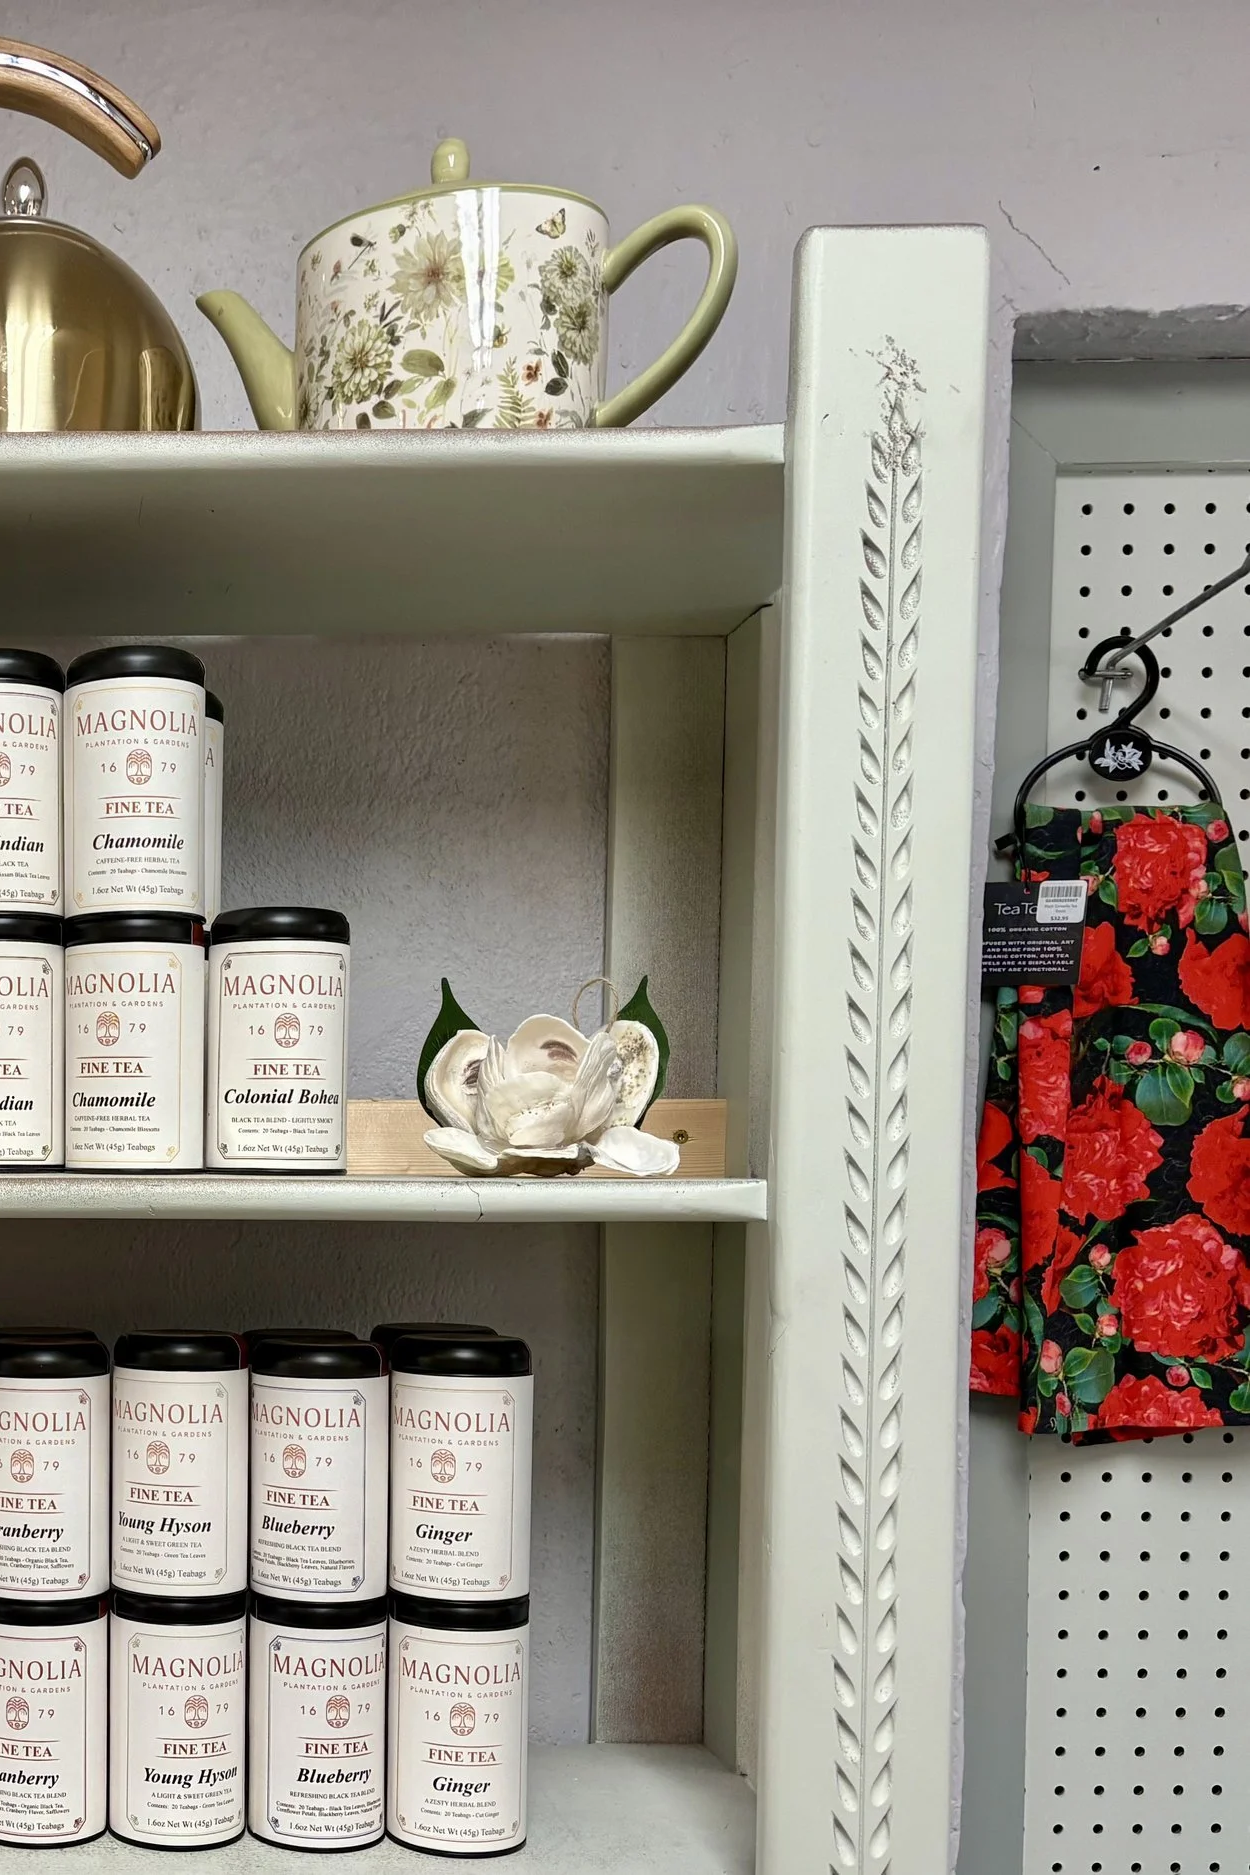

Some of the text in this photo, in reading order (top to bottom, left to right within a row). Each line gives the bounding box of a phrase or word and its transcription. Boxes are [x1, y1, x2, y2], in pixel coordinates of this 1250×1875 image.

[77, 709, 197, 736] MAGNOLIA
[4, 803, 33, 816] TEA
[105, 801, 174, 815] FINE TEA
[92, 834, 184, 850] Chamomile
[994, 903, 1020, 915] Tea
[67, 973, 176, 995] MAGNOLIA
[224, 974, 343, 997] MAGNOLIA
[80, 1062, 144, 1074] FINE TEA
[253, 1064, 321, 1076] FINE TEA
[73, 1092, 156, 1108] Chamomile
[225, 1089, 339, 1105] Colonial Bohea
[257, 1144, 271, 1152] Net
[272, 1144, 283, 1152] Wt
[285, 1144, 304, 1154] (45g)
[306, 1145, 328, 1153] Teabags
[114, 1400, 223, 1424] MAGNOLIA
[251, 1403, 361, 1428] MAGNOLIA
[394, 1406, 510, 1432] MAGNOLIA
[130, 1487, 193, 1503] FINE TEA
[266, 1490, 330, 1506] FINE TEA
[27, 1499, 57, 1510] TEA
[412, 1495, 479, 1512] FINE TEA
[118, 1512, 212, 1538] Young Hyson
[262, 1515, 335, 1539] Blueberry
[416, 1524, 473, 1545] Ginger
[132, 1650, 243, 1678] MAGNOLIA
[274, 1651, 385, 1678] MAGNOLIA
[402, 1657, 521, 1685] MAGNOLIA
[410, 1686, 462, 1698] PLANTATION
[23, 1746, 52, 1757] TEA
[163, 1740, 227, 1755] FINE TEA
[305, 1741, 368, 1755] FINE TEA
[429, 1748, 496, 1763] FINE TEA
[143, 1765, 238, 1789] Young Hyson
[297, 1767, 371, 1784] Blueberry
[432, 1776, 490, 1796] Ginger
[432, 1825, 445, 1834] Net
[447, 1826, 458, 1835] Wt
[460, 1827, 479, 1838] (45g)
[481, 1827, 505, 1836] Teabags
